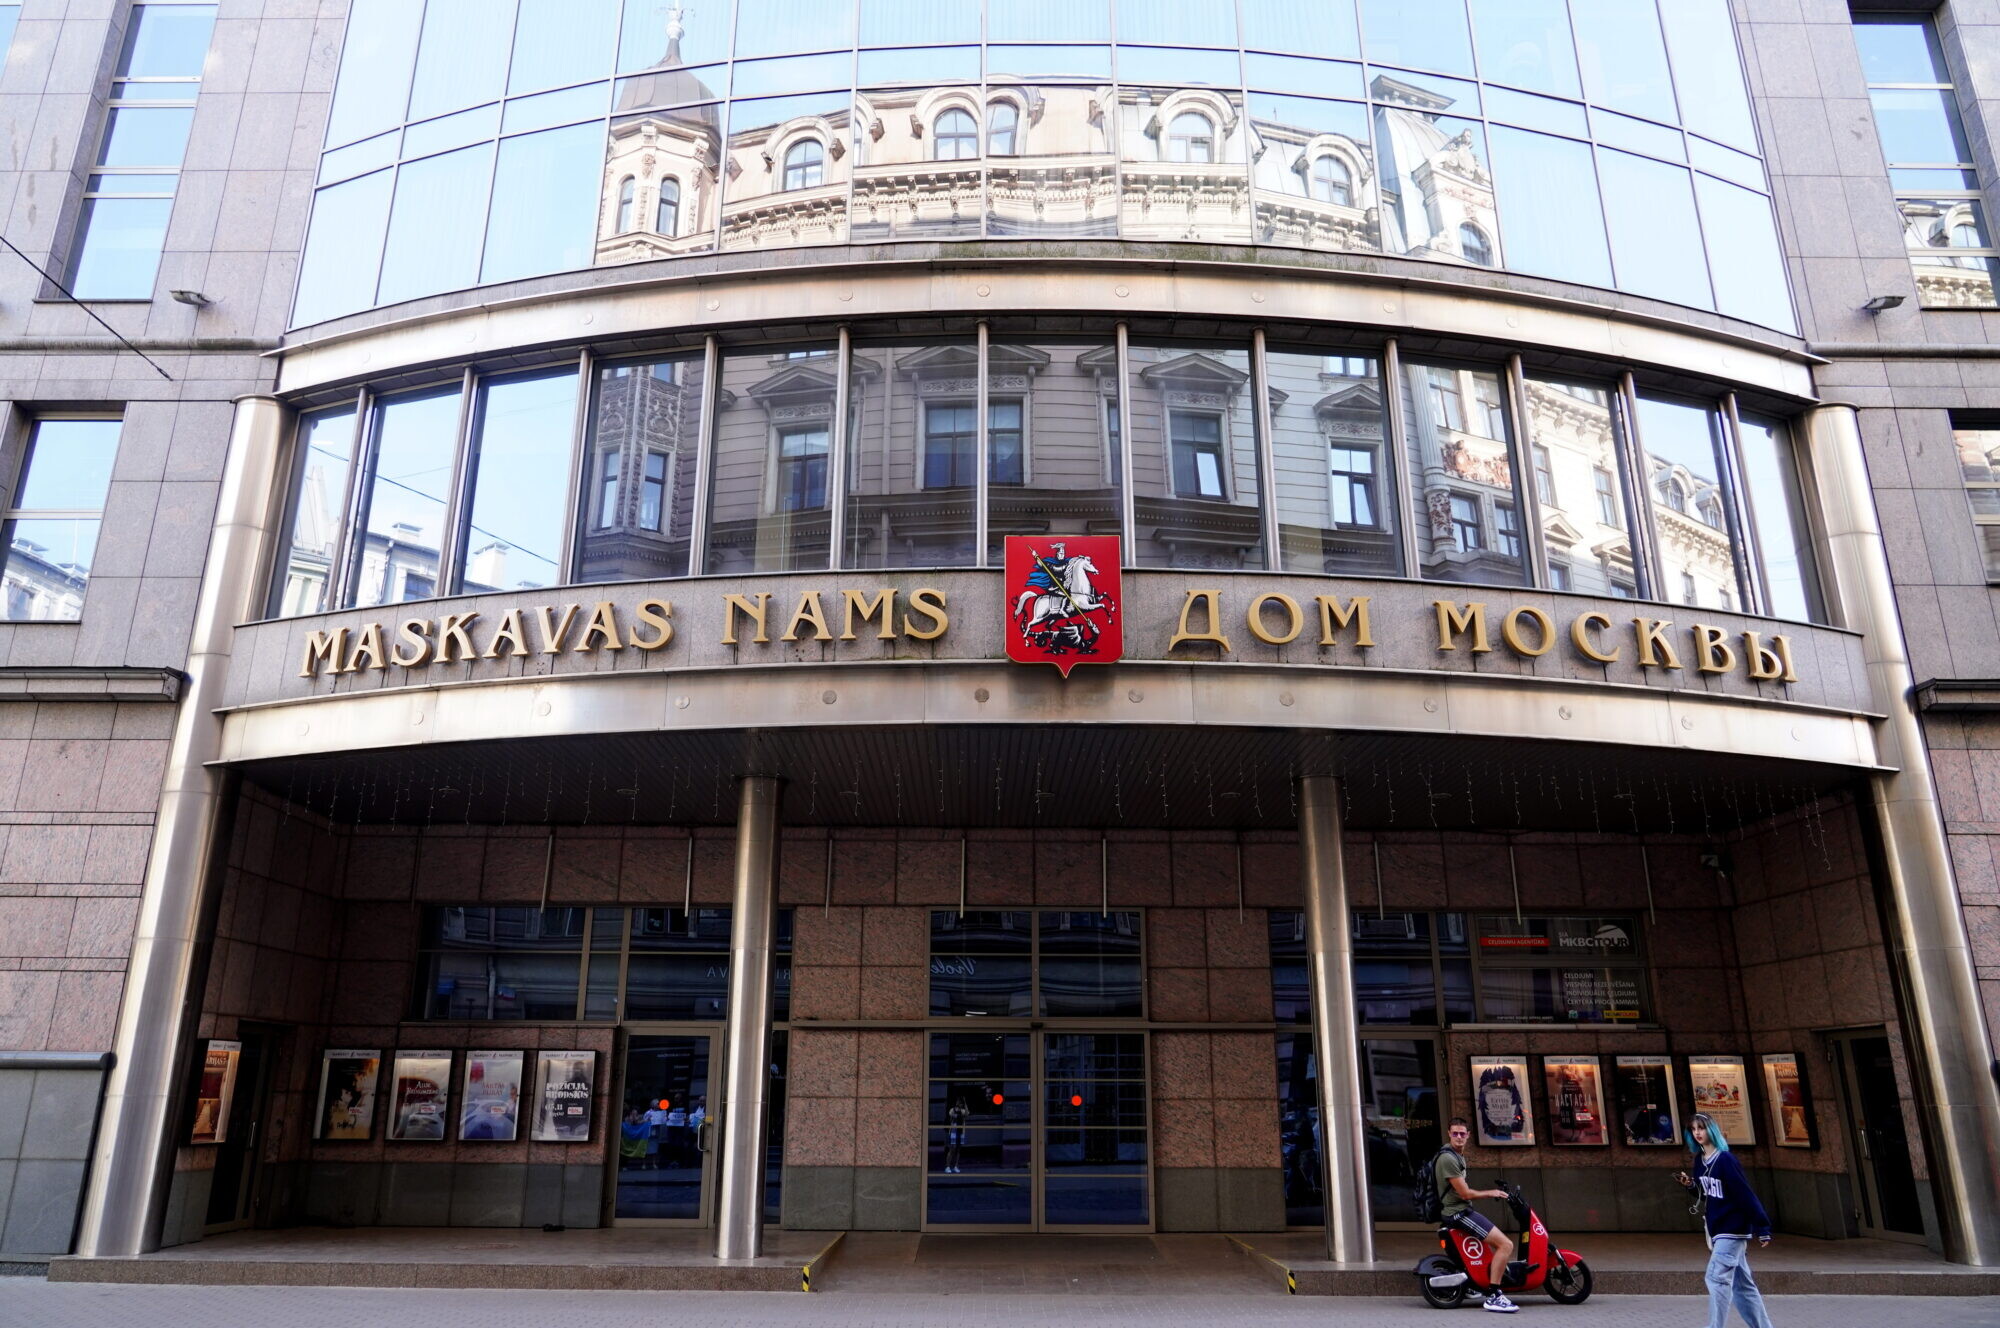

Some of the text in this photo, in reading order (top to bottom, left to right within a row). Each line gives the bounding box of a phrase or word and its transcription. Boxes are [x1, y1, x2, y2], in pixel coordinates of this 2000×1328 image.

[298, 588, 949, 678] MASKAVAS NAMS
[1168, 589, 1799, 682] ДОМ МОСКВЫ
